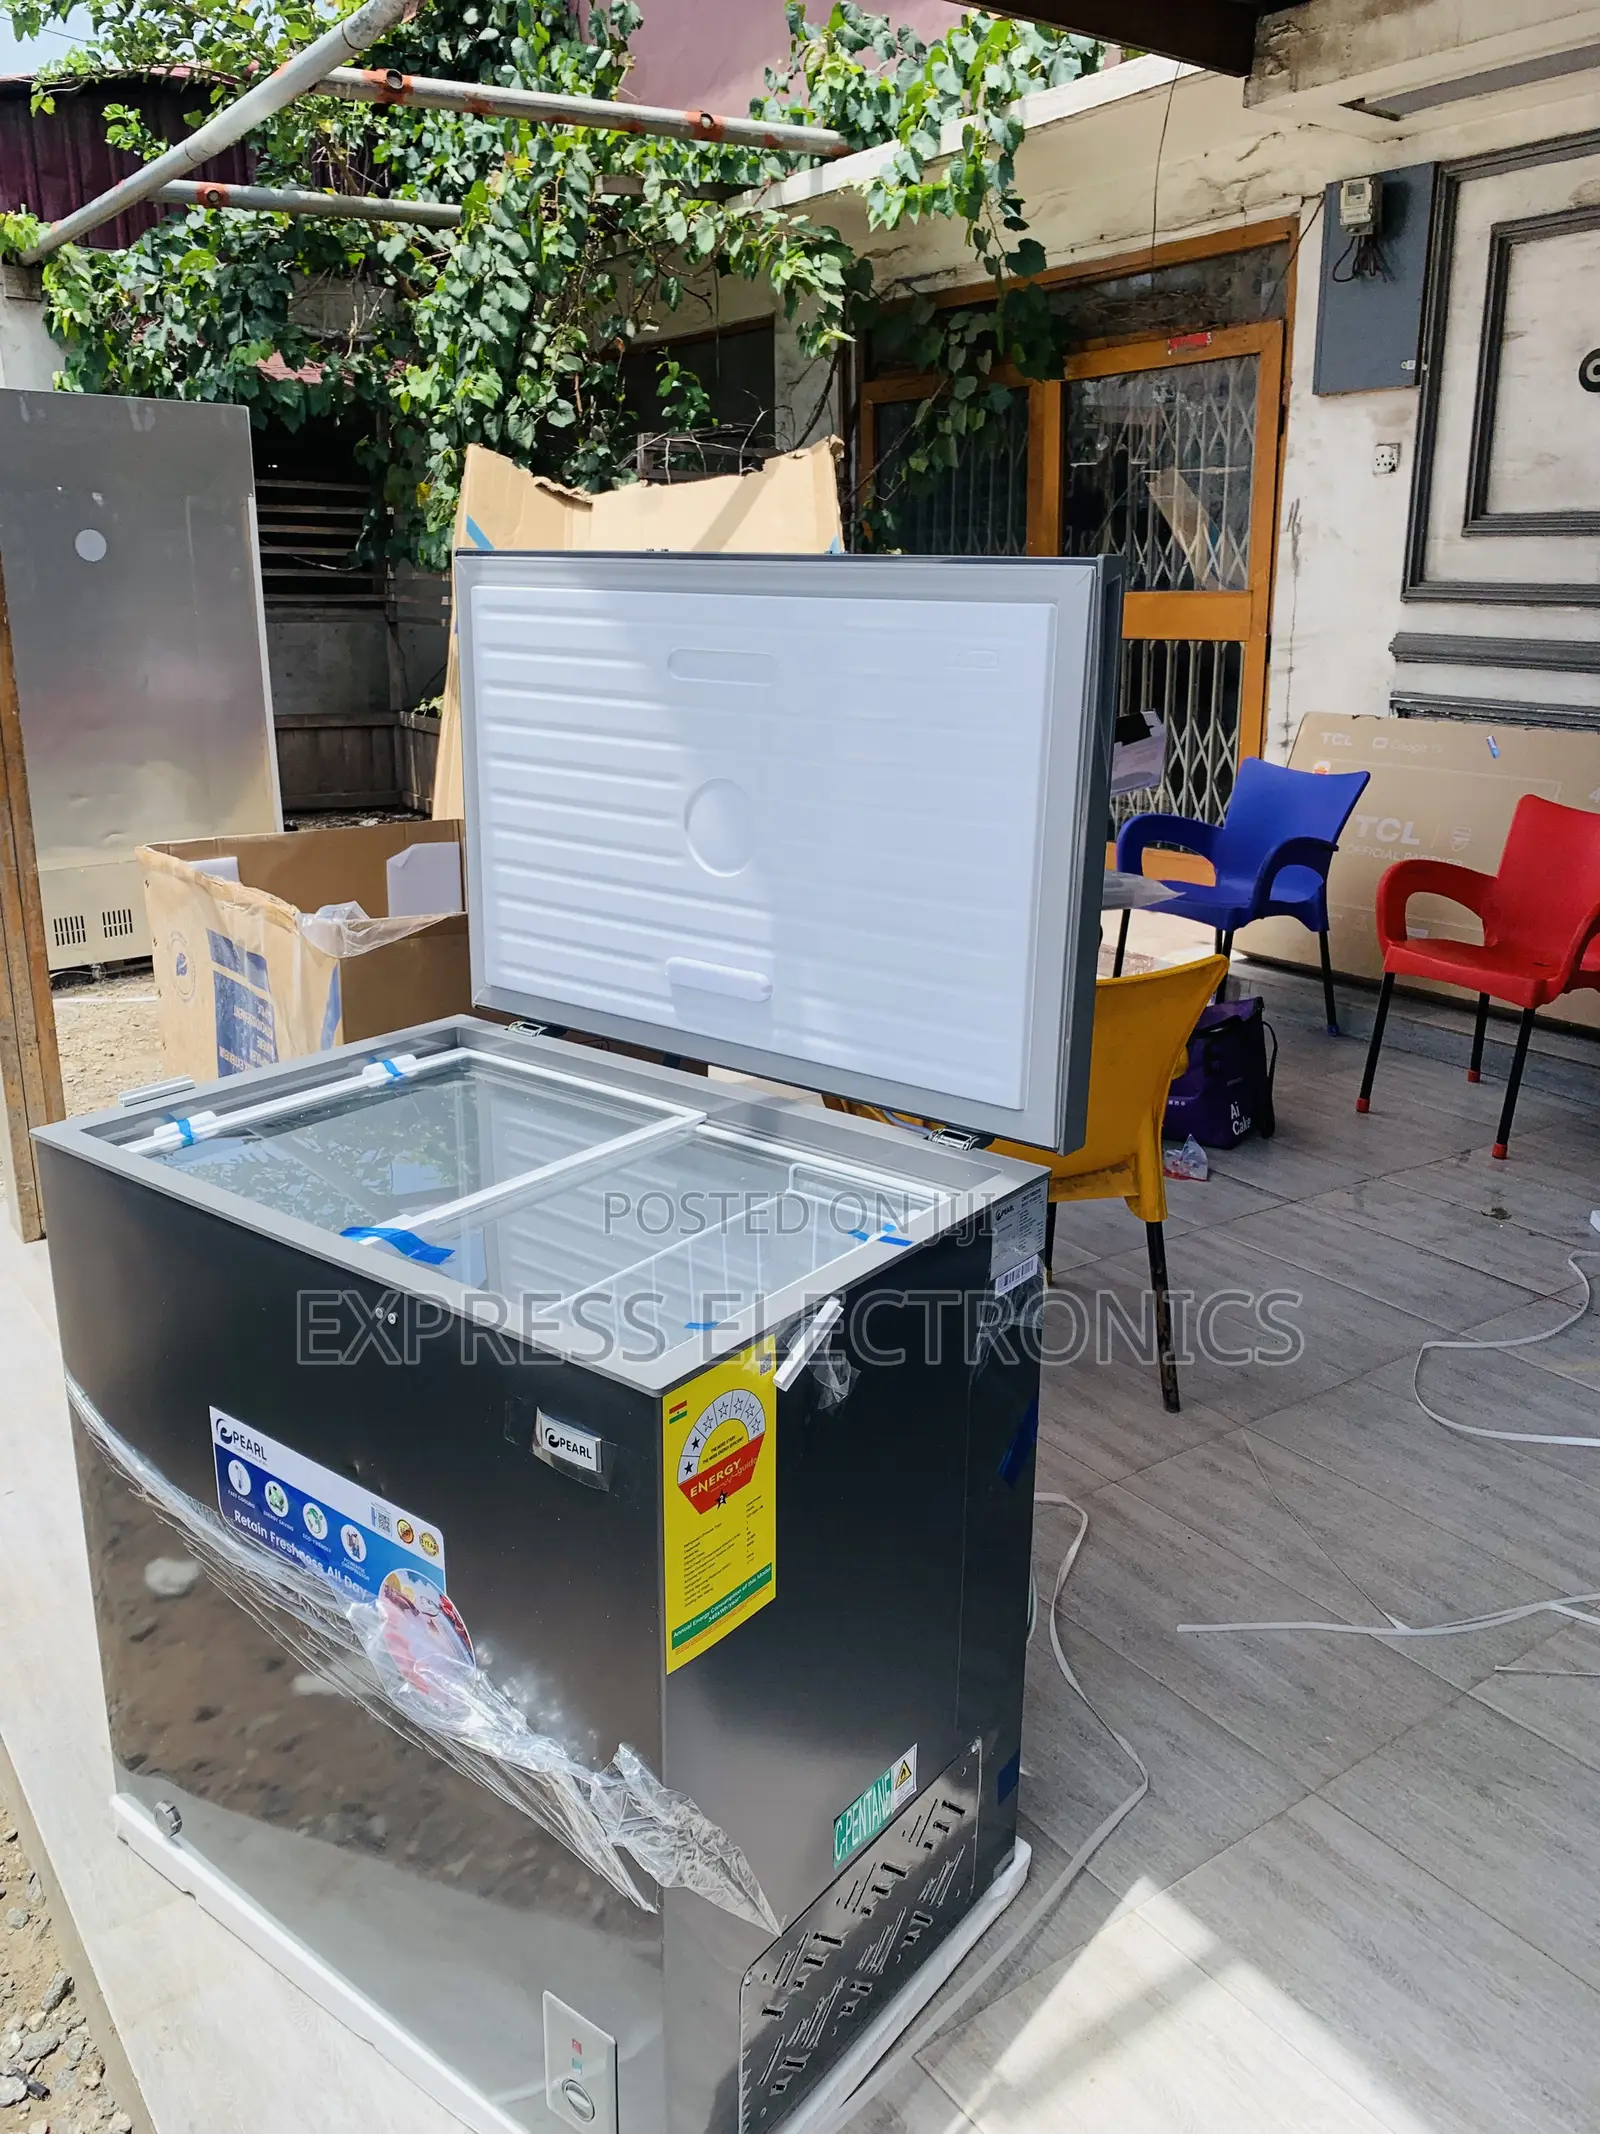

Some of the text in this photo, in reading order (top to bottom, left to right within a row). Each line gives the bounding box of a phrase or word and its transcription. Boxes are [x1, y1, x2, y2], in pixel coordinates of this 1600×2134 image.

[1321, 732, 1353, 747] TCL
[1355, 814, 1421, 846] TCL
[1345, 843, 1402, 861] OFFICIAL
[232, 1430, 268, 1461] PEARL
[559, 1437, 592, 1460] PEARL
[690, 1458, 741, 1498] ENERGY
[234, 1509, 268, 1540] Retain
[327, 1565, 342, 1582] All
[344, 1574, 367, 1600] Day
[835, 1773, 891, 1861] C-PENTANE
